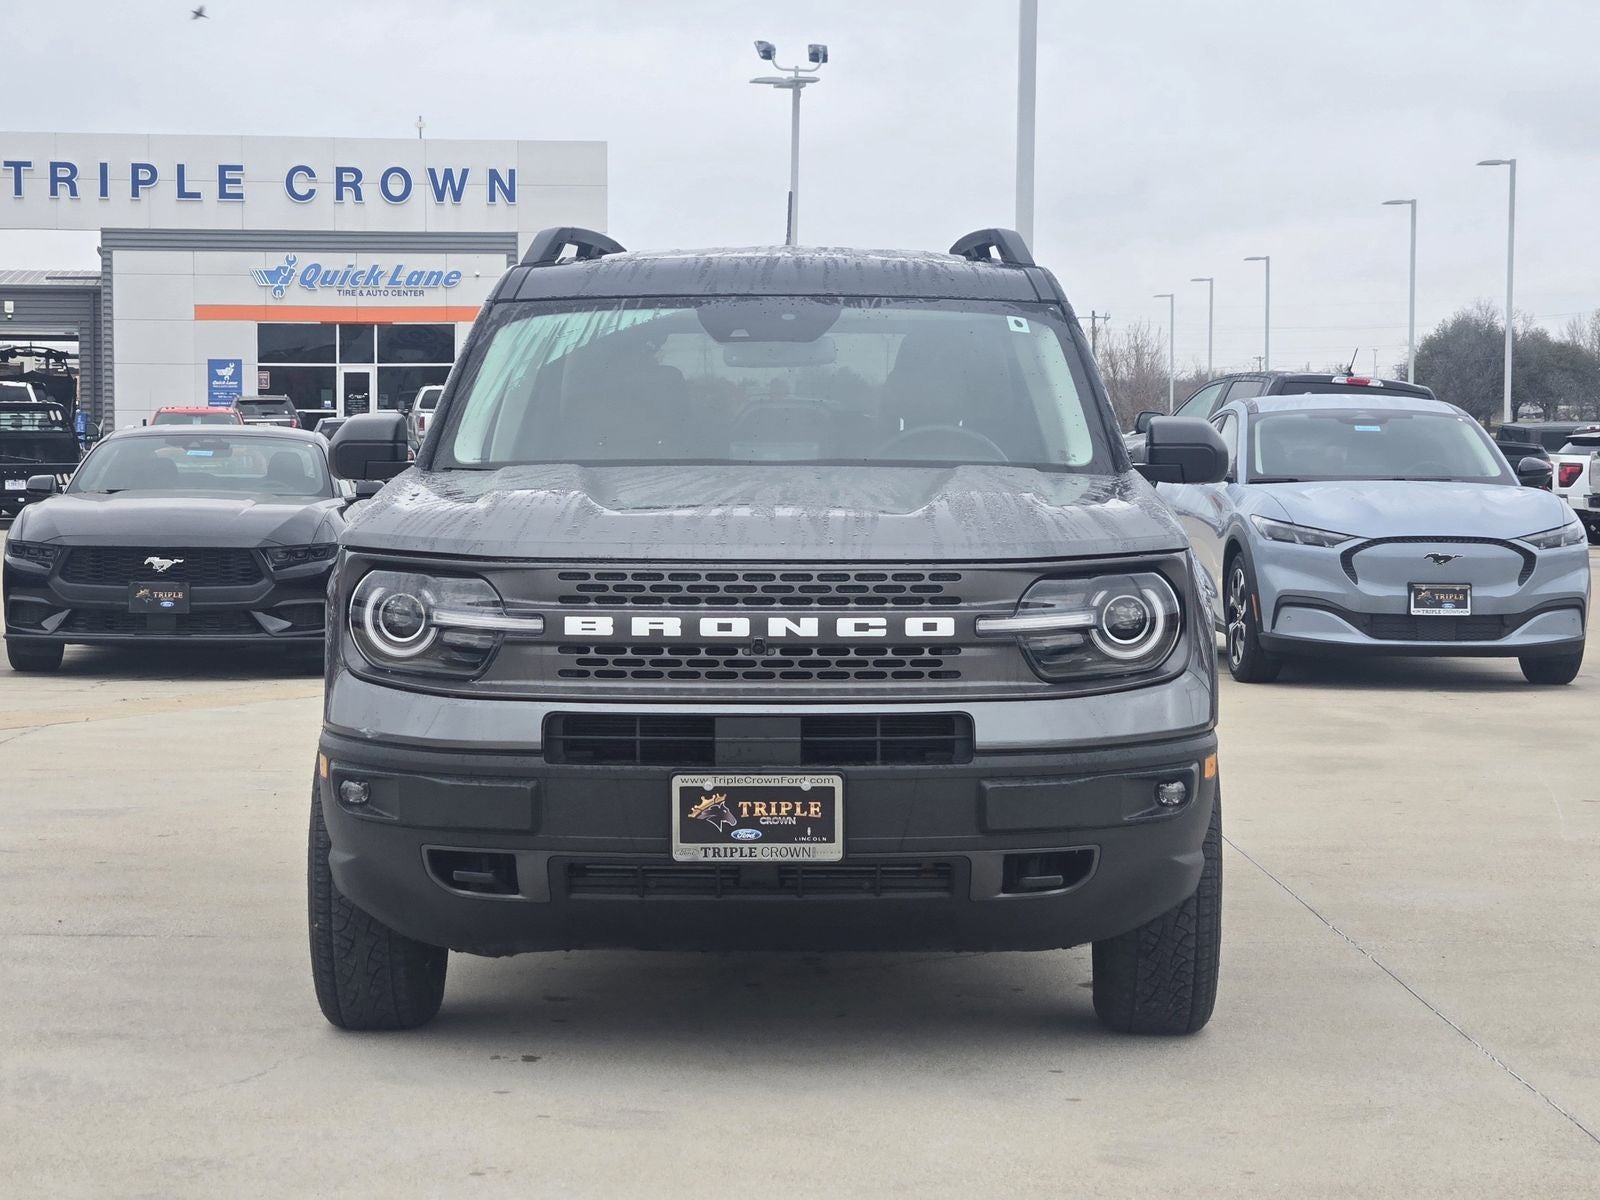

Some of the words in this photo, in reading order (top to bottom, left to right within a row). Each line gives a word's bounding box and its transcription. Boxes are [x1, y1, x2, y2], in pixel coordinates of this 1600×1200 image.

[3, 160, 245, 201] TRIPLE
[284, 164, 518, 204] CROWN
[300, 263, 385, 290] Quick
[386, 264, 462, 288] Lane
[337, 289, 357, 297] TIRE
[358, 289, 365, 297] &
[366, 289, 389, 297] AUTO
[391, 289, 425, 297] CENTER
[564, 616, 955, 637] BRONCO
[680, 776, 834, 785] wwwTripleCrownFordcom
[738, 801, 822, 818] TRIPLE
[760, 816, 797, 825] CROWN
[700, 847, 757, 858] TRIPLE
[761, 847, 811, 858] CROWN
